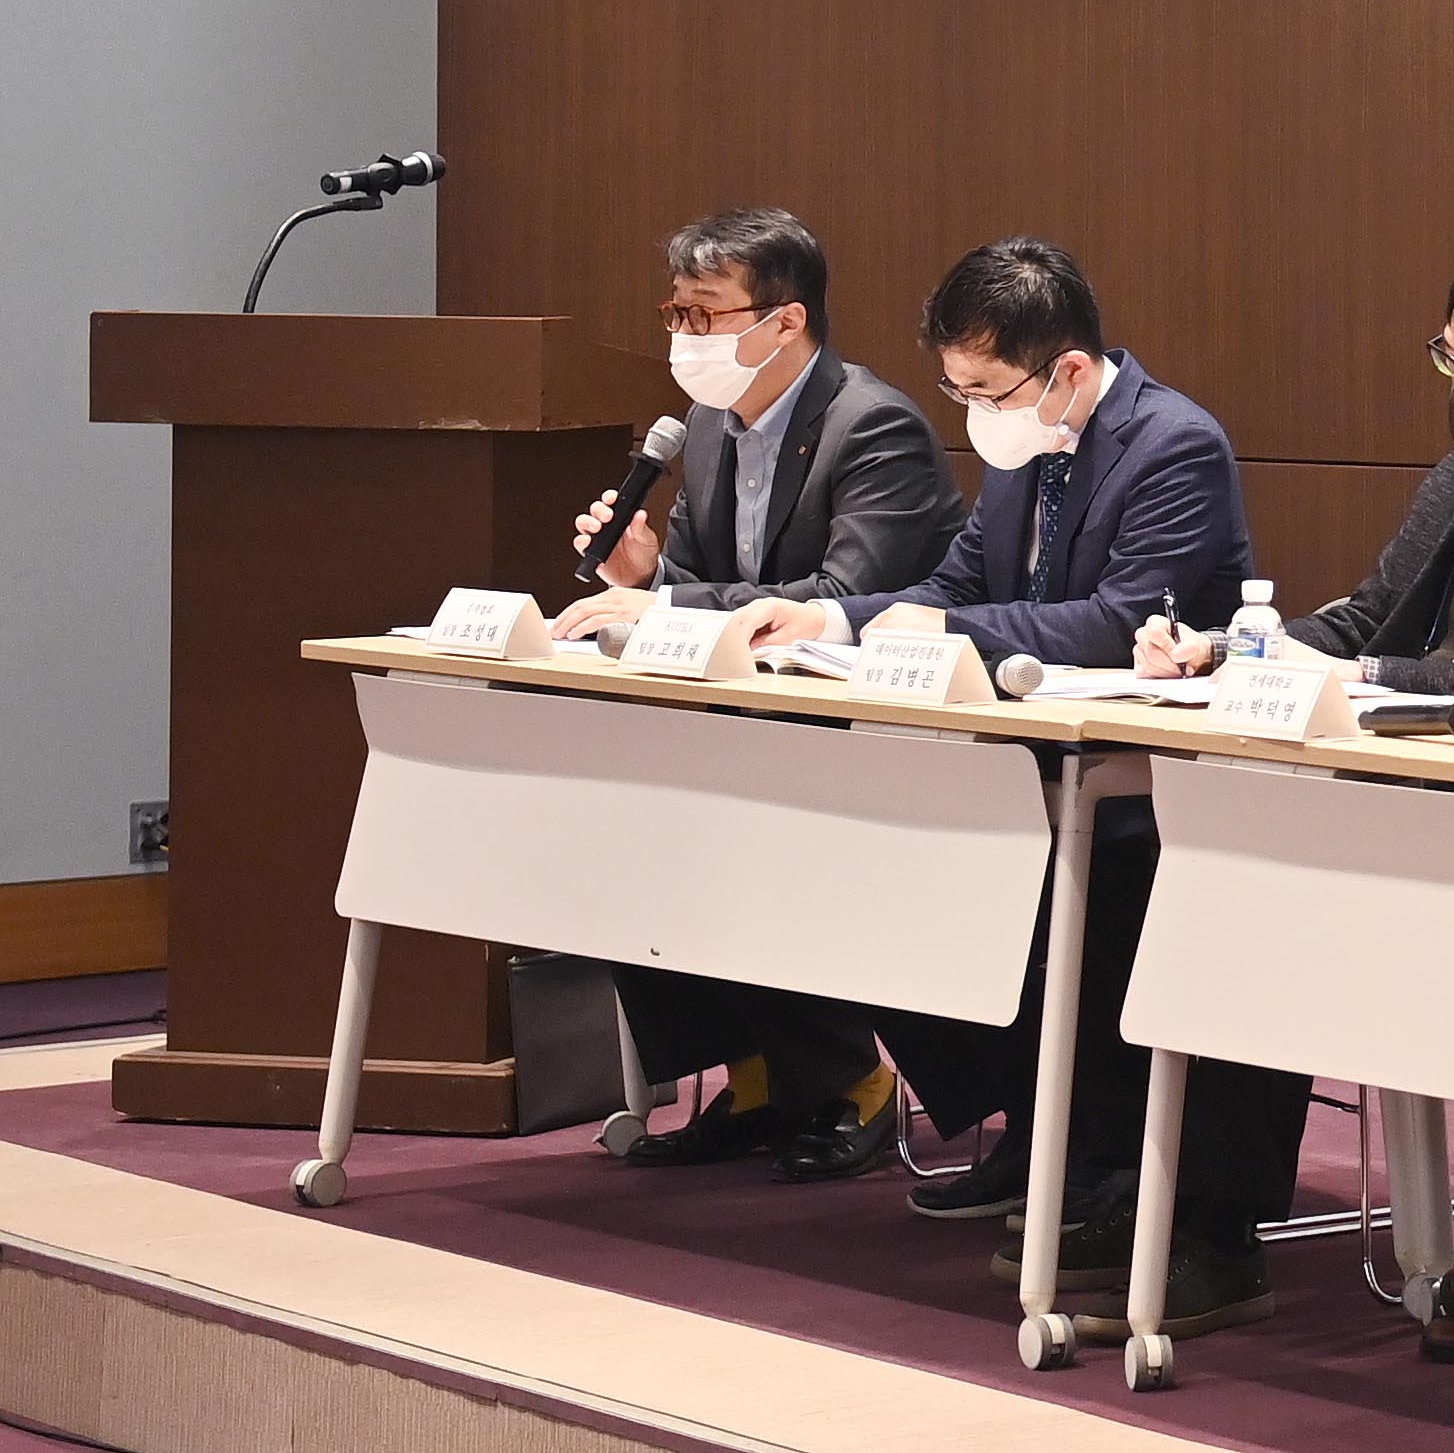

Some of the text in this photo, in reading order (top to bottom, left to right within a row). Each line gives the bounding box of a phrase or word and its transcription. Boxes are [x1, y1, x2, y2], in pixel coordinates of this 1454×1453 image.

[875, 642, 945, 661] 데이터산업진흥원
[865, 667, 884, 683] 팀장
[1248, 673, 1294, 689] 연세대학교
[1223, 699, 1244, 715] 교수
